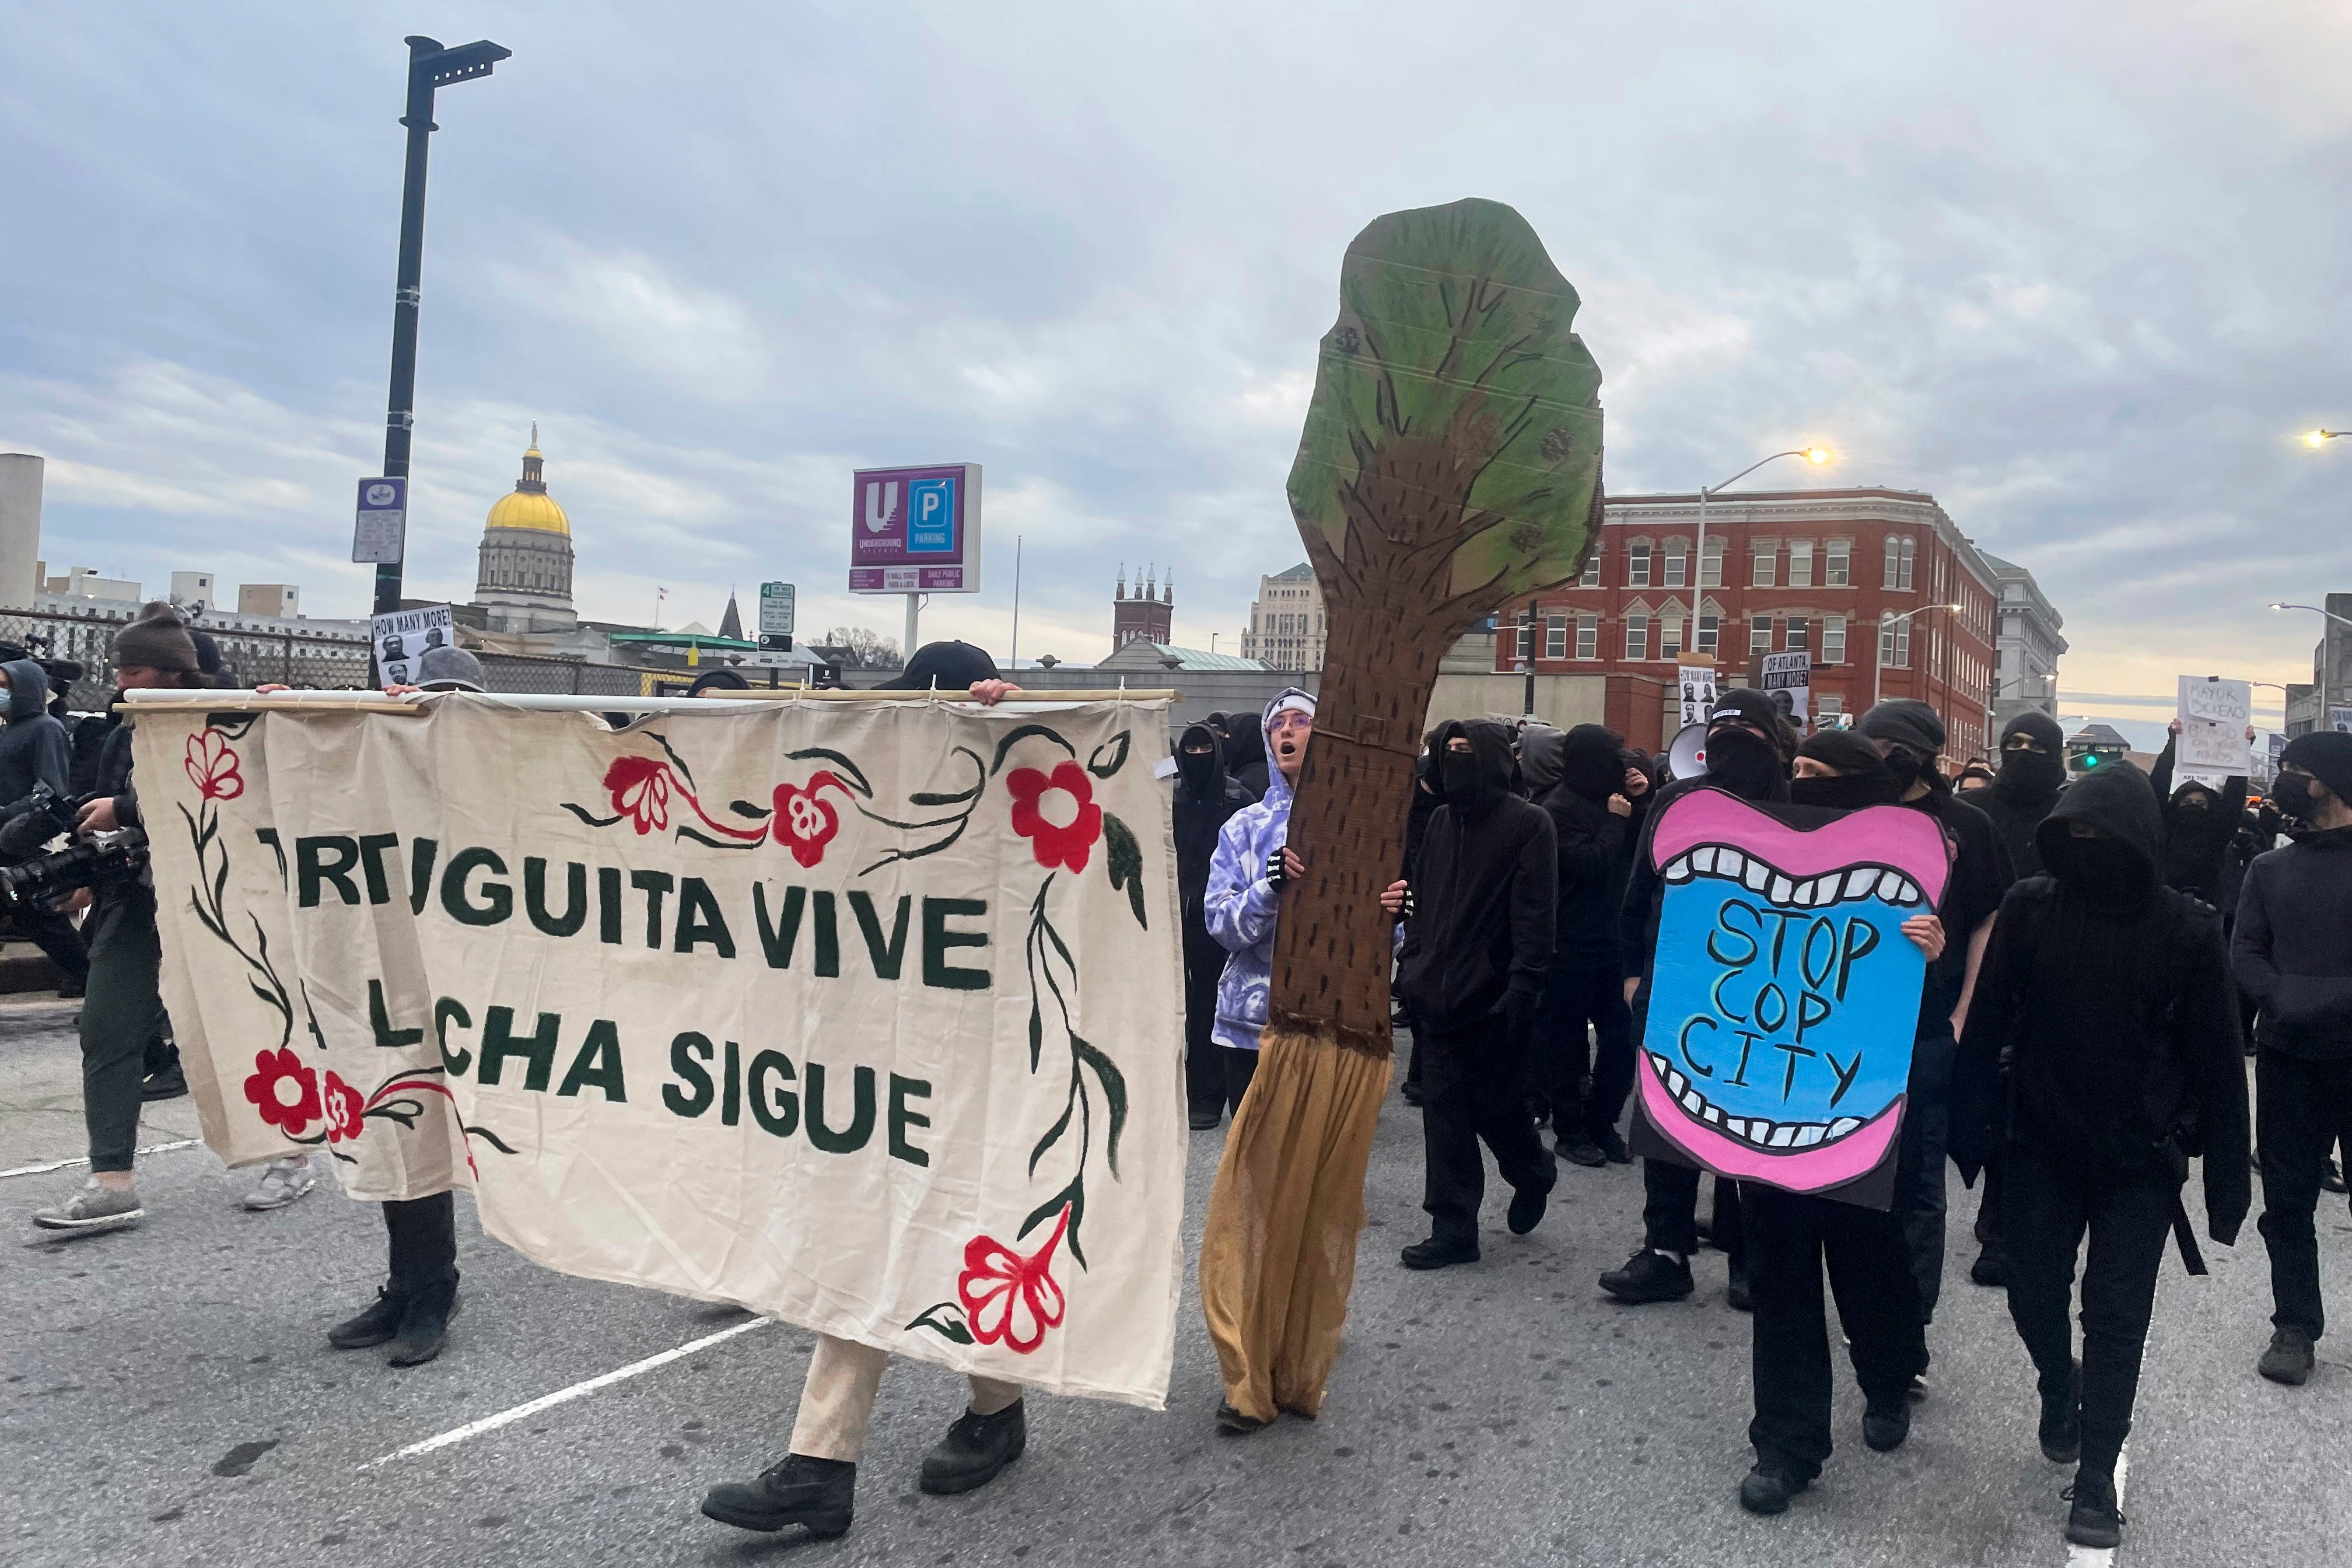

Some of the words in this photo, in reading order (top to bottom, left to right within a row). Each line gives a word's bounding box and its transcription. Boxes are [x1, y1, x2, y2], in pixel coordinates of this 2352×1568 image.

[859, 538, 902, 549] UNDERGROUND
[915, 533, 946, 544] PARKING
[928, 570, 941, 578] DAILY
[942, 569, 960, 578] PUBLIC
[933, 579, 955, 587] PARKING
[762, 585, 770, 596] 4
[374, 618, 394, 636] HOW
[397, 614, 420, 632] MANY
[423, 608, 451, 629] MORE?
[1768, 657, 1777, 671] OF
[1778, 654, 1808, 670] ATLANTA,
[1766, 673, 1786, 690] MANY
[1786, 670, 1807, 688] MORE?
[2190, 684, 2238, 702] MAYOR
[2192, 699, 2246, 720] DICKENS
[752, 881, 993, 991] VIVE
[1707, 899, 1880, 1003] STOP
[1712, 967, 1832, 1044] COP
[1679, 1014, 1861, 1109] CITY
[368, 978, 627, 1103] LCHA
[662, 1031, 932, 1168] SIGUE
